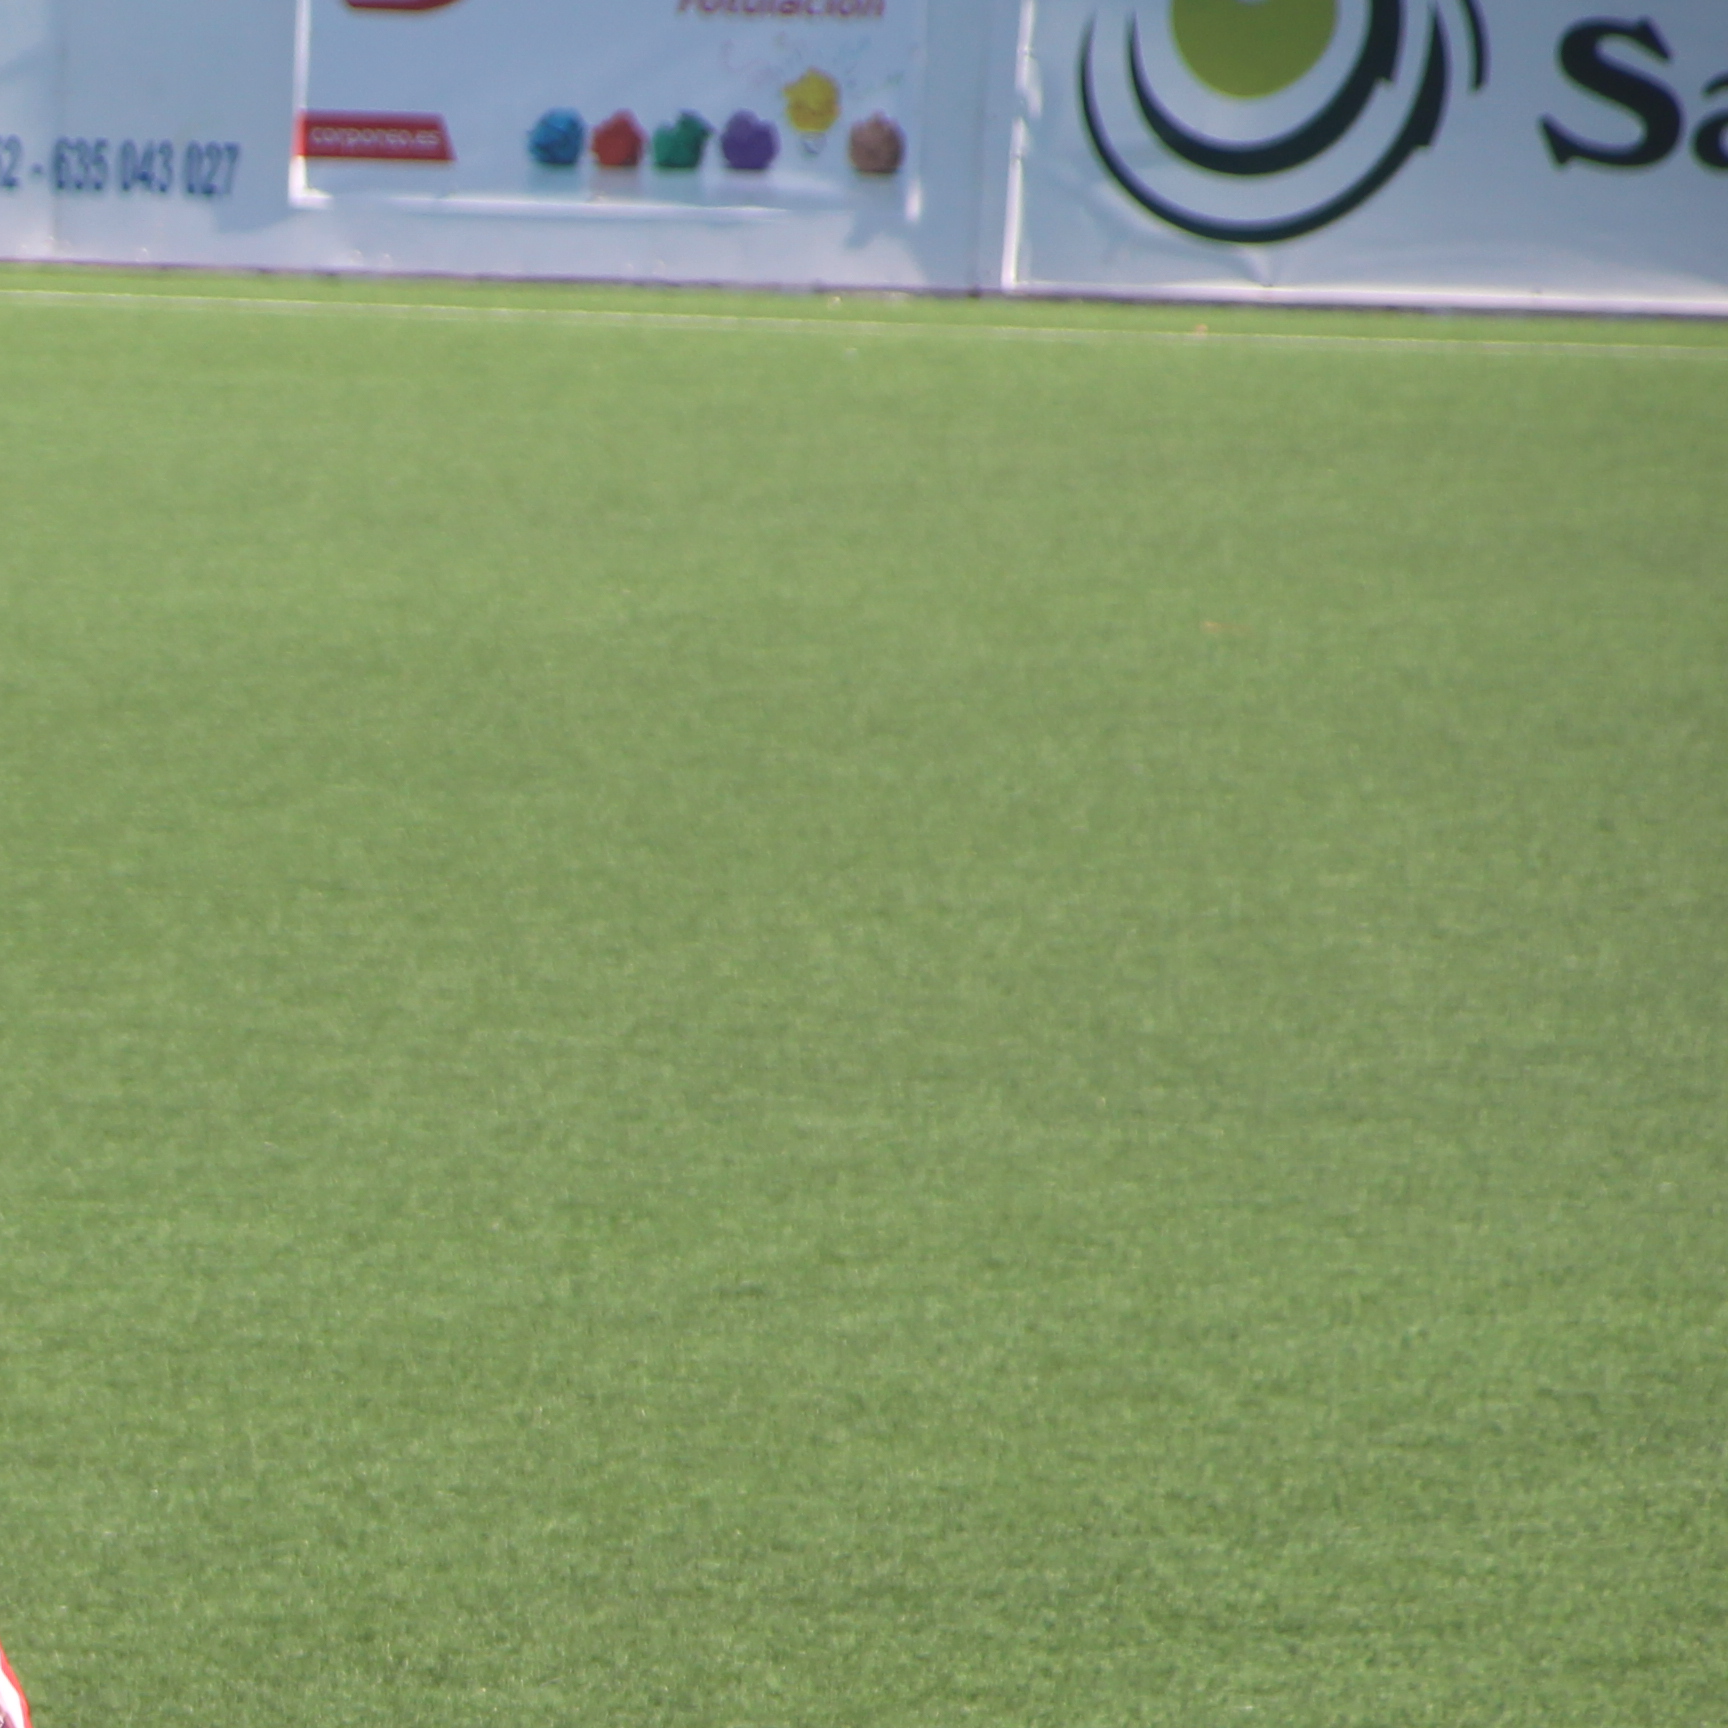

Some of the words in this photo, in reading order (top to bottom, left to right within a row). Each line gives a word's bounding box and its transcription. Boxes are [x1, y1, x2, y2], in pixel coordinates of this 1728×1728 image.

[54, 136, 111, 191] 635
[120, 138, 174, 194] 043
[185, 140, 242, 196] 027
